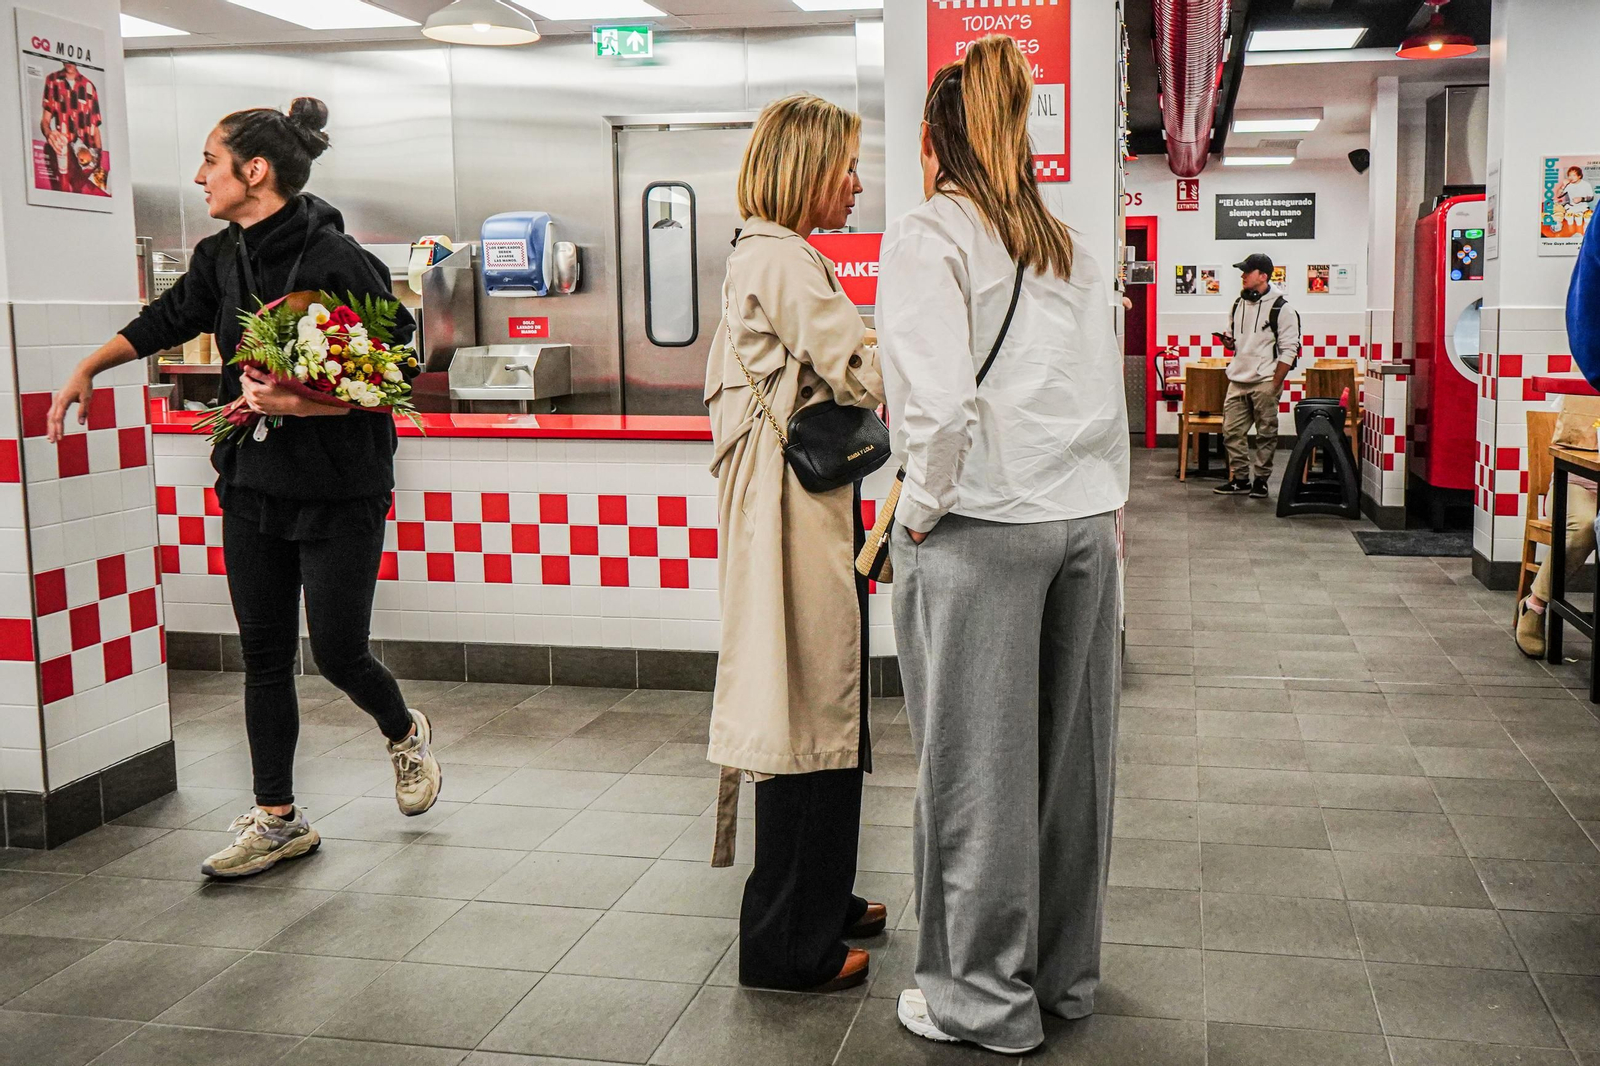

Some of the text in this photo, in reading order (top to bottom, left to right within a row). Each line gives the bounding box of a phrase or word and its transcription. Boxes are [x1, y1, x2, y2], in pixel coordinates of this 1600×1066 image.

[962, 14, 1032, 31] TODAY’S
[31, 36, 91, 62] GQ MODA
[1037, 94, 1057, 116] NL
[1543, 158, 1559, 225] billboard
[1234, 199, 1254, 207] éxito
[1255, 199, 1271, 207] está
[1272, 198, 1313, 208] asegurado
[1229, 209, 1260, 218] siempre
[1260, 208, 1270, 216] de
[1271, 208, 1279, 216] la
[1238, 219, 1248, 227] de
[1248, 219, 1265, 227] Five
